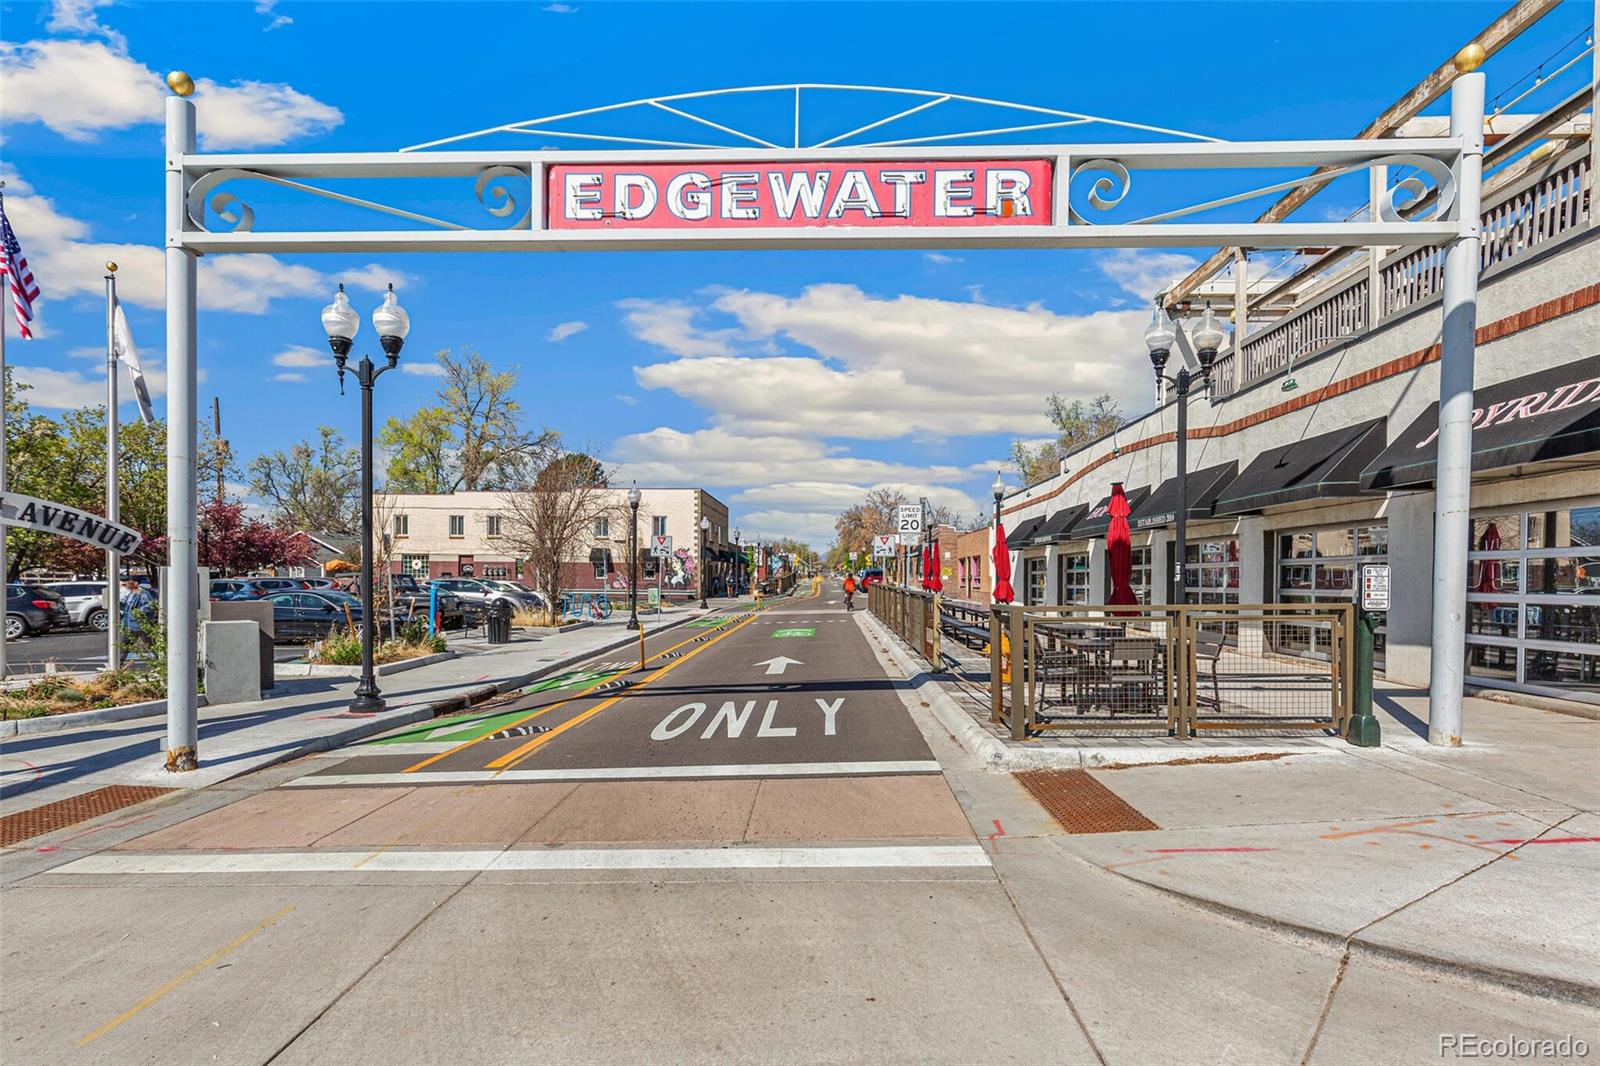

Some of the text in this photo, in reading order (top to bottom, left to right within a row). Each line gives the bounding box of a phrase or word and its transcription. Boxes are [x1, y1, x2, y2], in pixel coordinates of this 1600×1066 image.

[563, 168, 1033, 221] EDGEWATER
[18, 502, 138, 553] AVENUE
[901, 519, 919, 530] 20
[650, 698, 845, 741] ONLY
